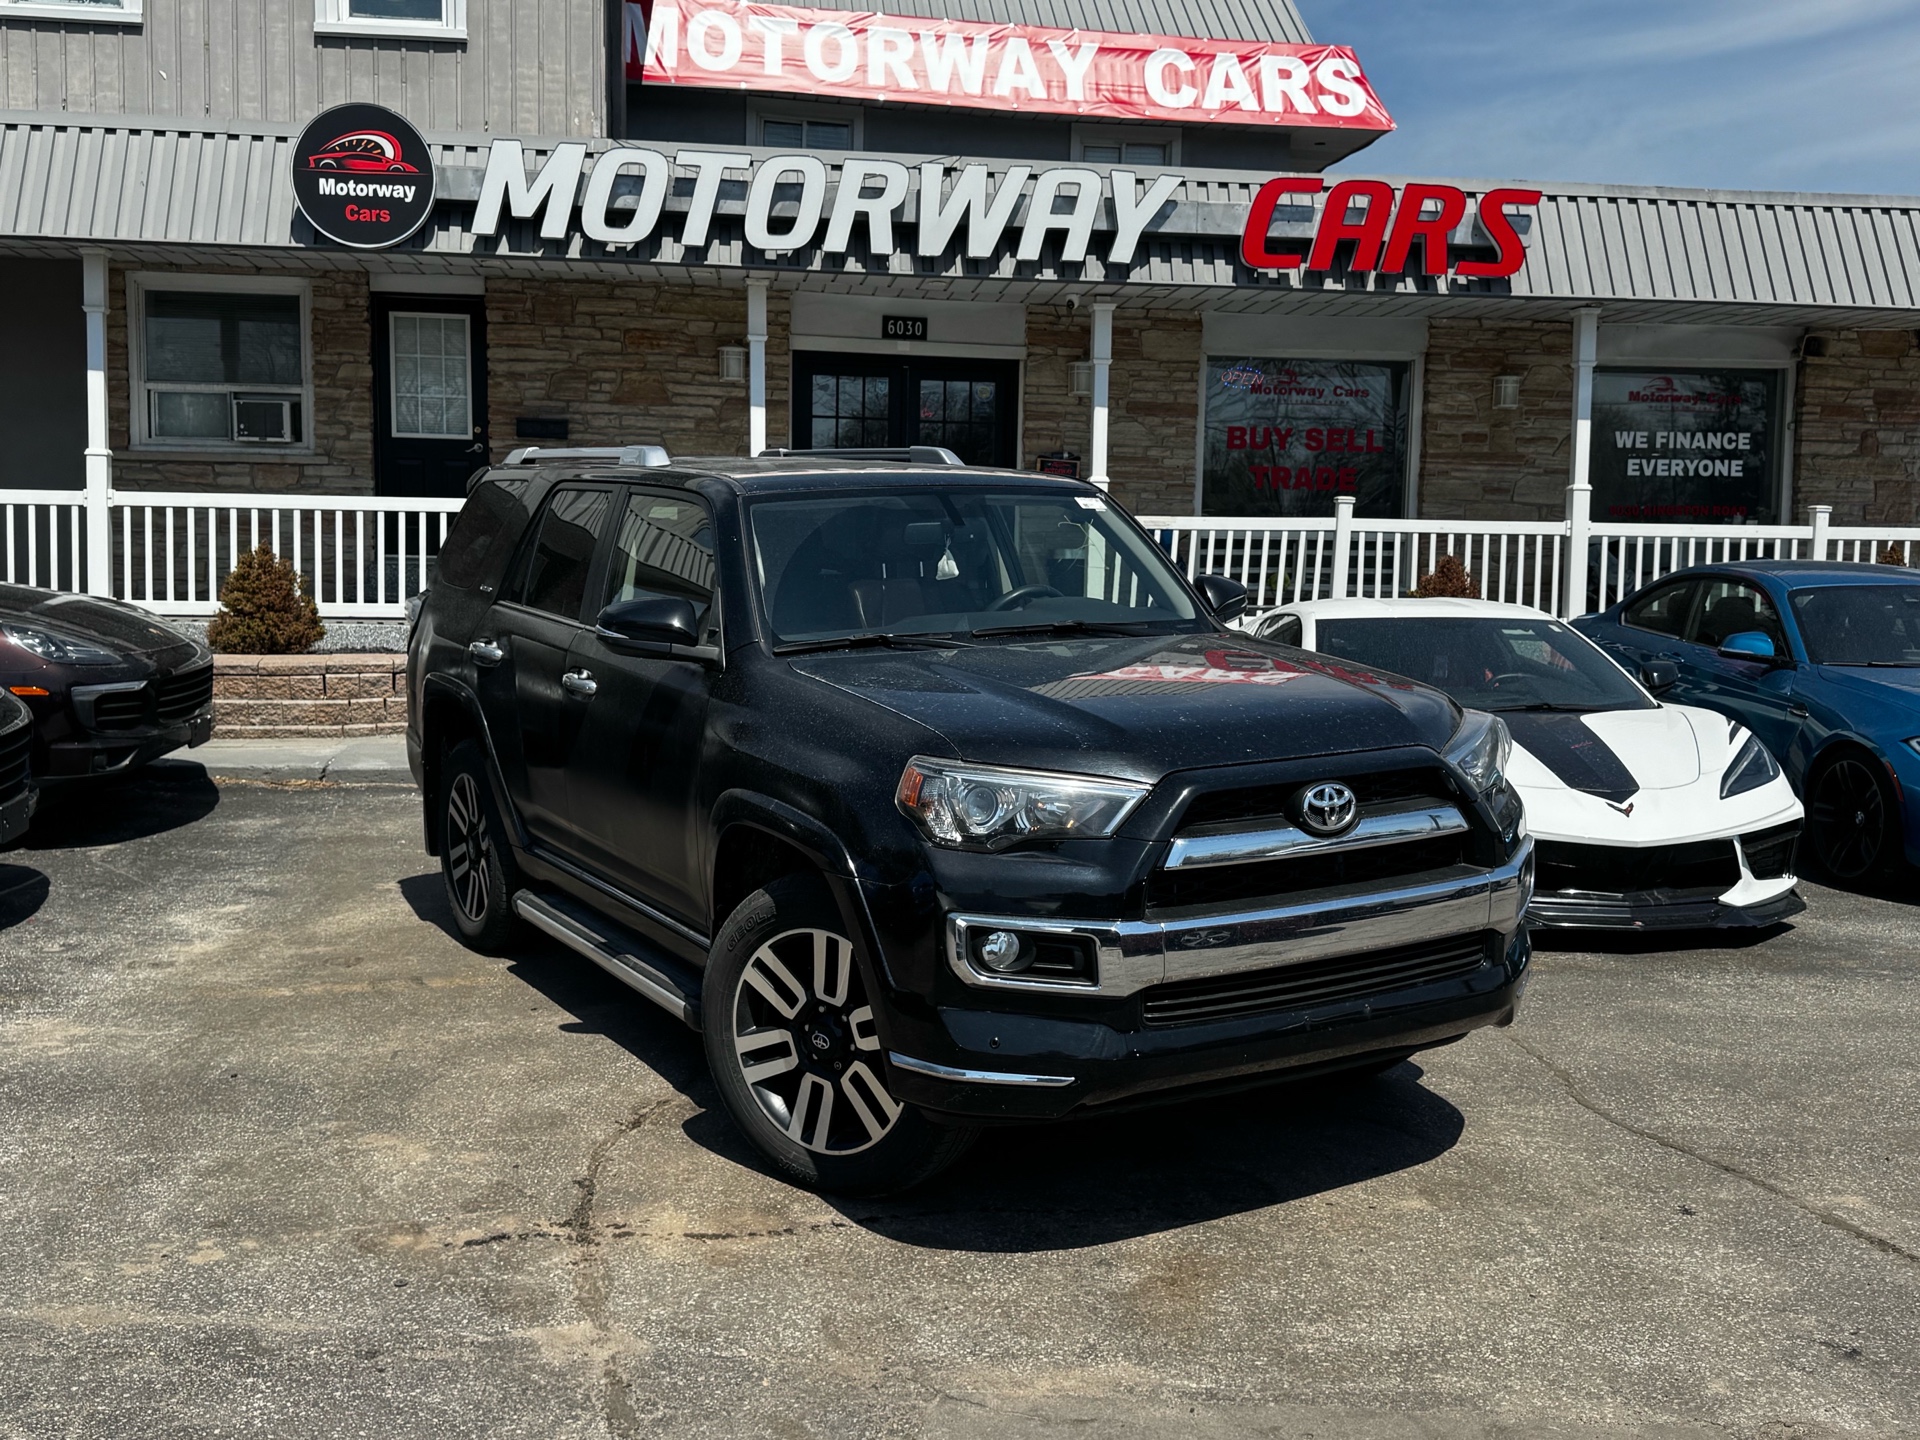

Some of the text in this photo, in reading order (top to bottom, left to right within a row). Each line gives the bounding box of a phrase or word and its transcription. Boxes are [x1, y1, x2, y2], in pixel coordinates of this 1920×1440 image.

[625, 2, 1366, 117] MOTORWAY CARS
[318, 177, 416, 203] Motorway
[345, 204, 391, 222] Cars
[471, 138, 1543, 278] MOTORWAY CARS
[888, 320, 922, 336] 6030
[1221, 371, 1264, 385] OPEN
[1250, 383, 1370, 398] Motorway Cars
[1628, 391, 1699, 405] Motorway
[1226, 426, 1384, 452] BUY SELL
[1615, 431, 1751, 450] WE FINANCE
[1627, 459, 1743, 477] EVERYONE
[1249, 465, 1358, 491] TRADE
[1712, 505, 1747, 517] ROAD
